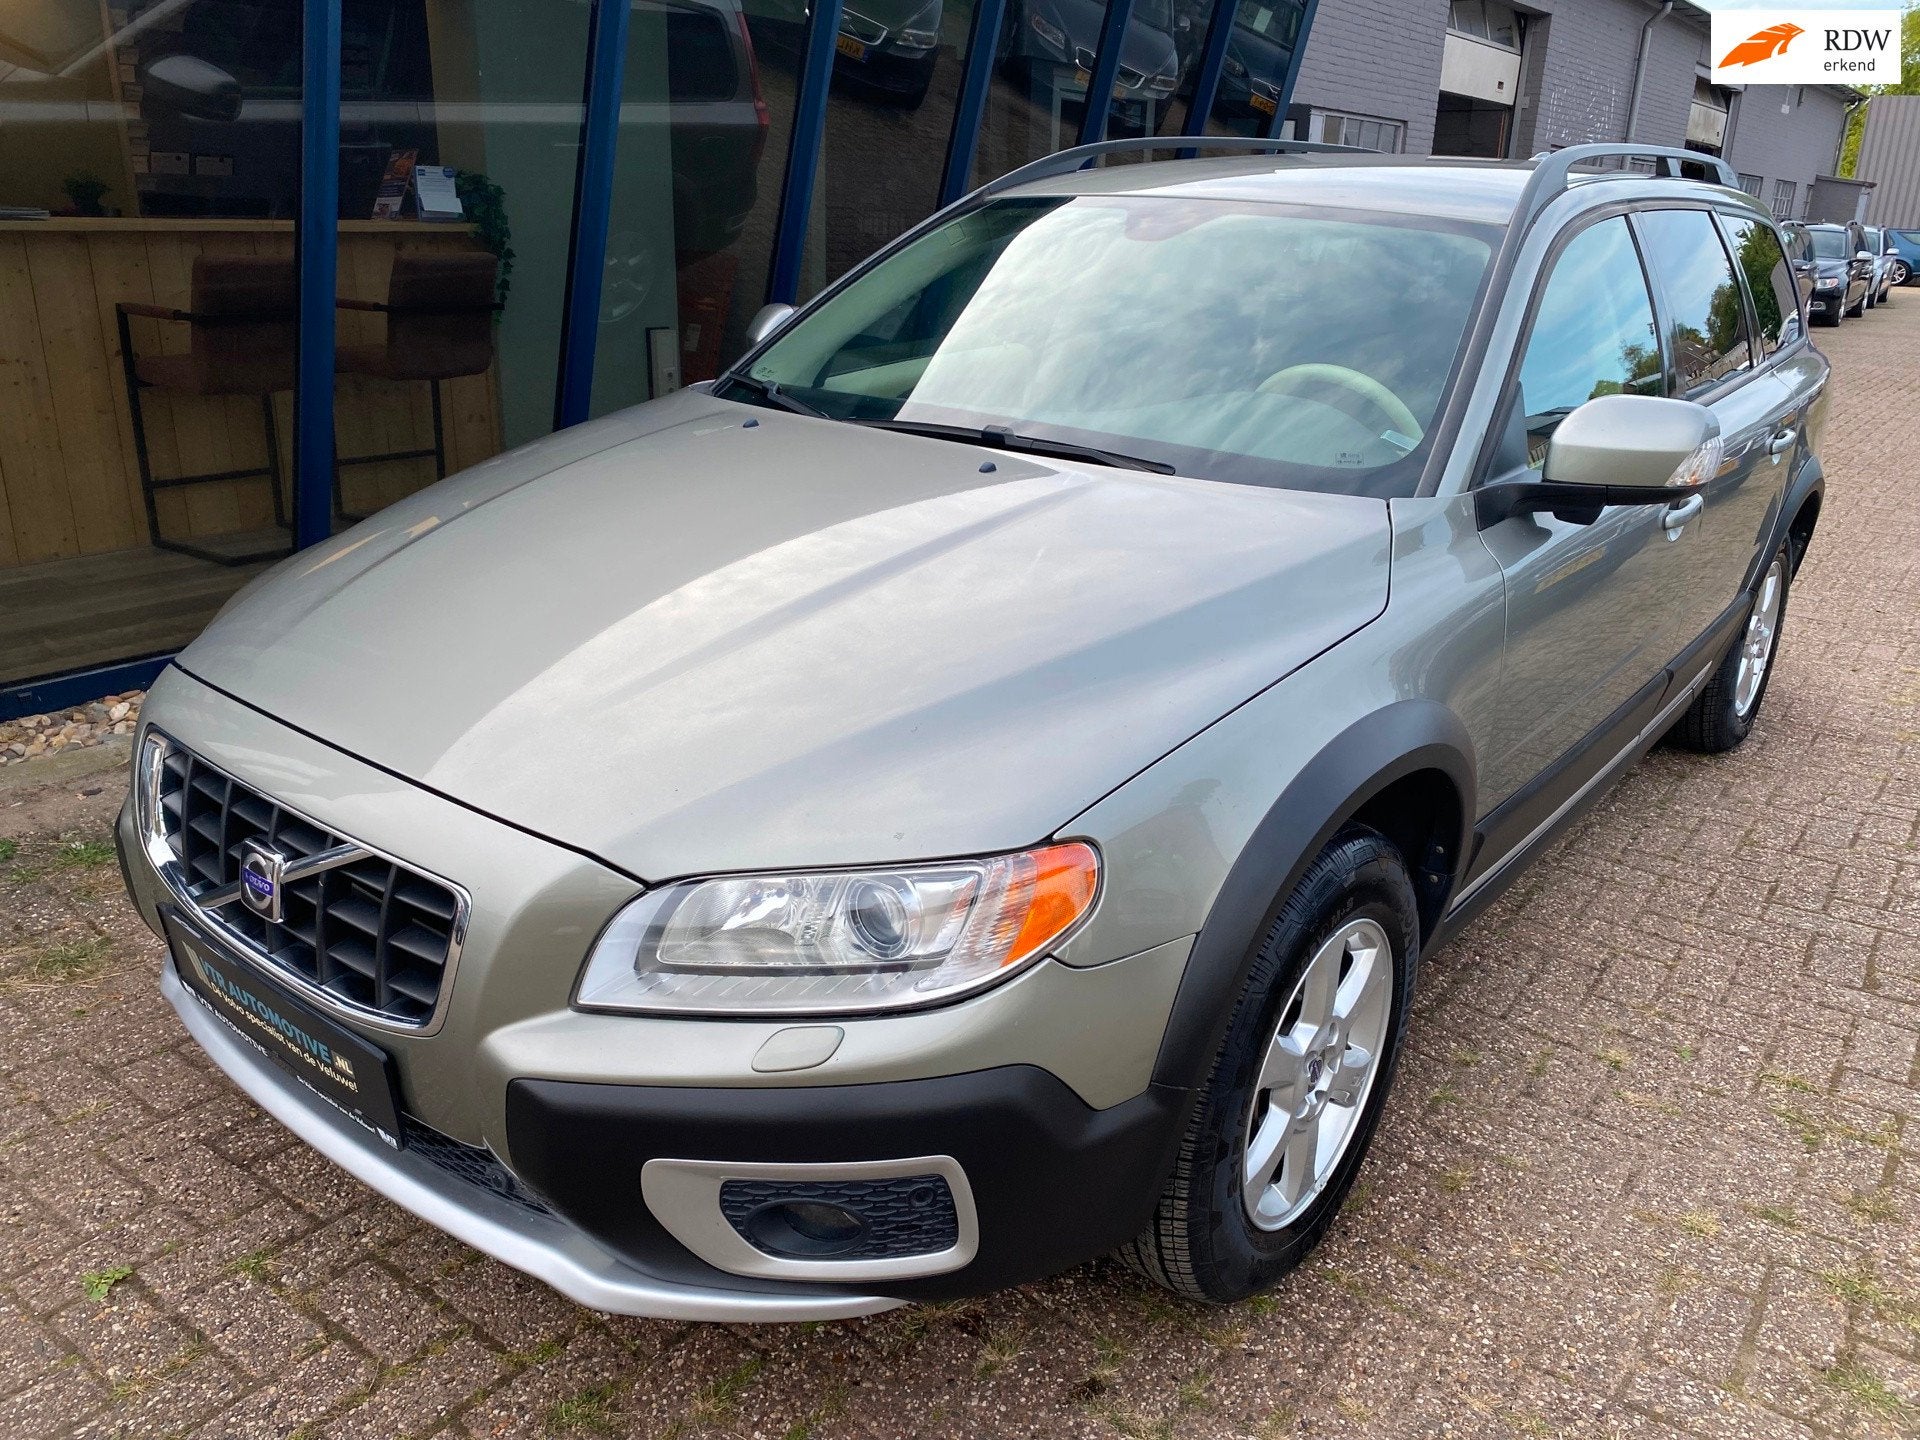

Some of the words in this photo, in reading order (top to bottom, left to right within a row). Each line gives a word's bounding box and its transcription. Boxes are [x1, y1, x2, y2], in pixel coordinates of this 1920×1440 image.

[245, 872, 270, 892] VOLVO
[200, 957, 227, 992] VTR
[229, 981, 332, 1064] AUTOMOTIVE
[335, 1055, 354, 1075] .NL
[222, 995, 245, 1015] Volvo
[246, 1010, 285, 1045] specialist
[286, 1041, 304, 1058] van
[304, 1052, 316, 1067] de
[317, 1059, 359, 1093] Veluwe!
